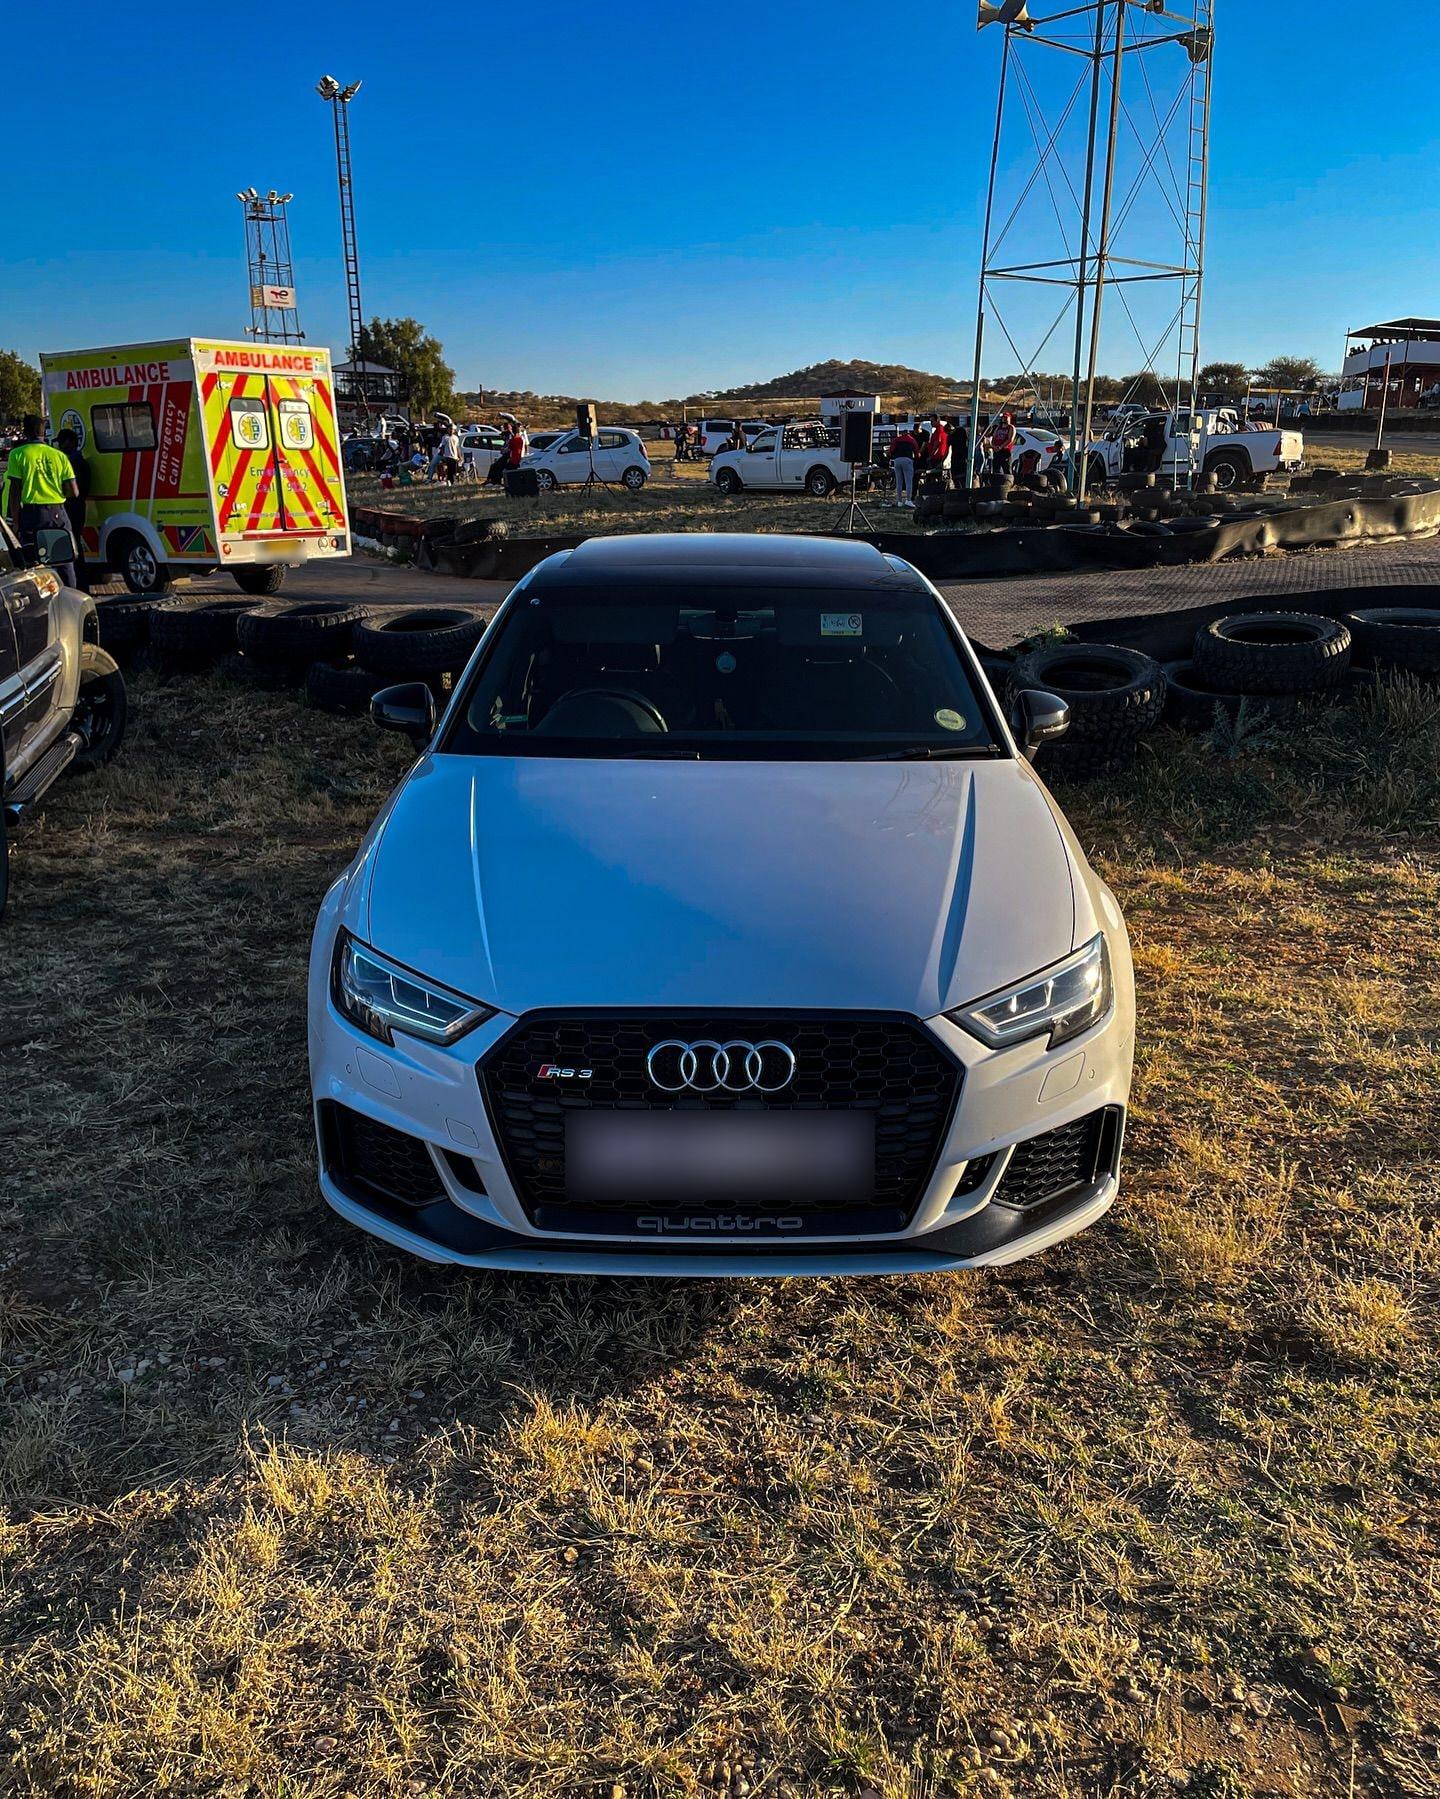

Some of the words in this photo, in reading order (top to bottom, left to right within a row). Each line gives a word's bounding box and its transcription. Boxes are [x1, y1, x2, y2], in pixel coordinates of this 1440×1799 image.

[214, 350, 313, 371] AMBULANCE
[66, 361, 170, 390] AMBULANCE
[174, 409, 186, 445] 9112
[157, 399, 176, 482] Emergency
[169, 456, 181, 486] Call
[250, 466, 309, 478] Emgency
[287, 482, 307, 492] 92
[546, 1067, 575, 1078] RS
[578, 1069, 593, 1078] 3
[636, 1214, 803, 1233] quattro
